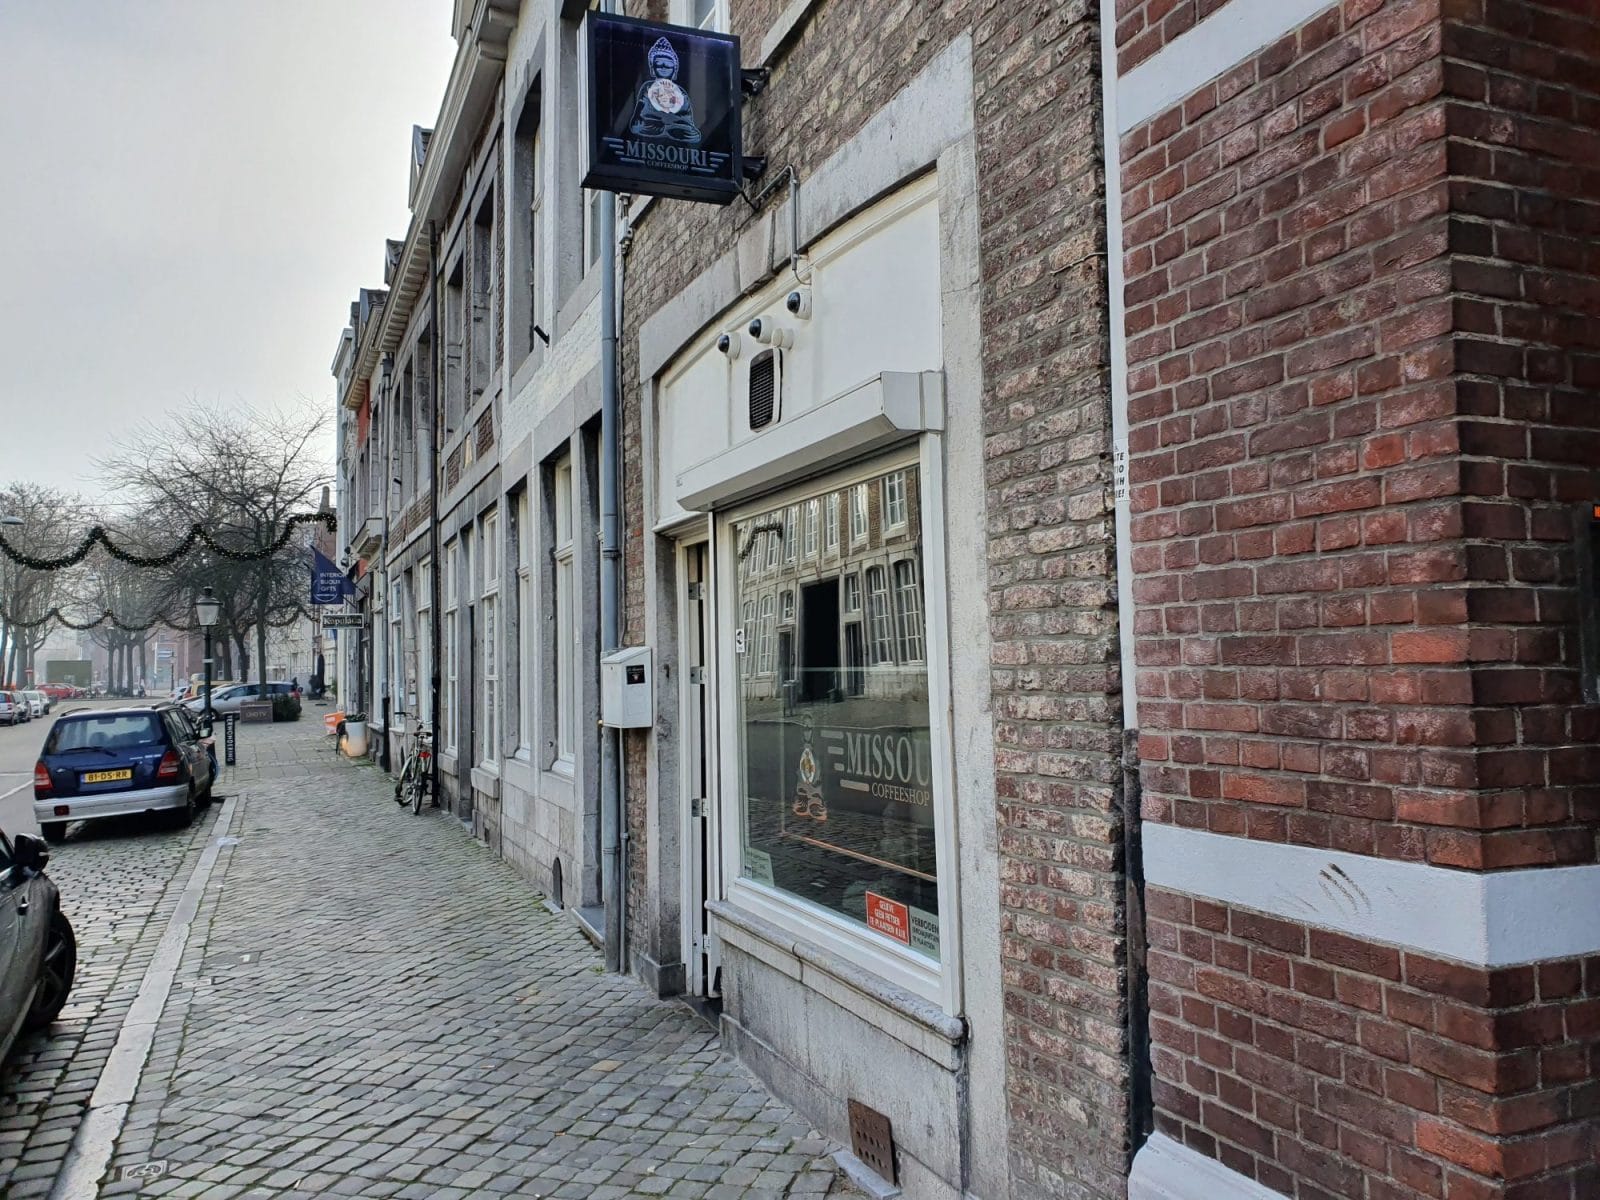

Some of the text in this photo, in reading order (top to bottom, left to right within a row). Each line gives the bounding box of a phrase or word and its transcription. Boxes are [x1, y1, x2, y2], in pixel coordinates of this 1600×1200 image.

[626, 140, 708, 166] MISSOURI
[646, 160, 689, 171] COFFEESHOP
[871, 782, 930, 806] COFFEESHOP
